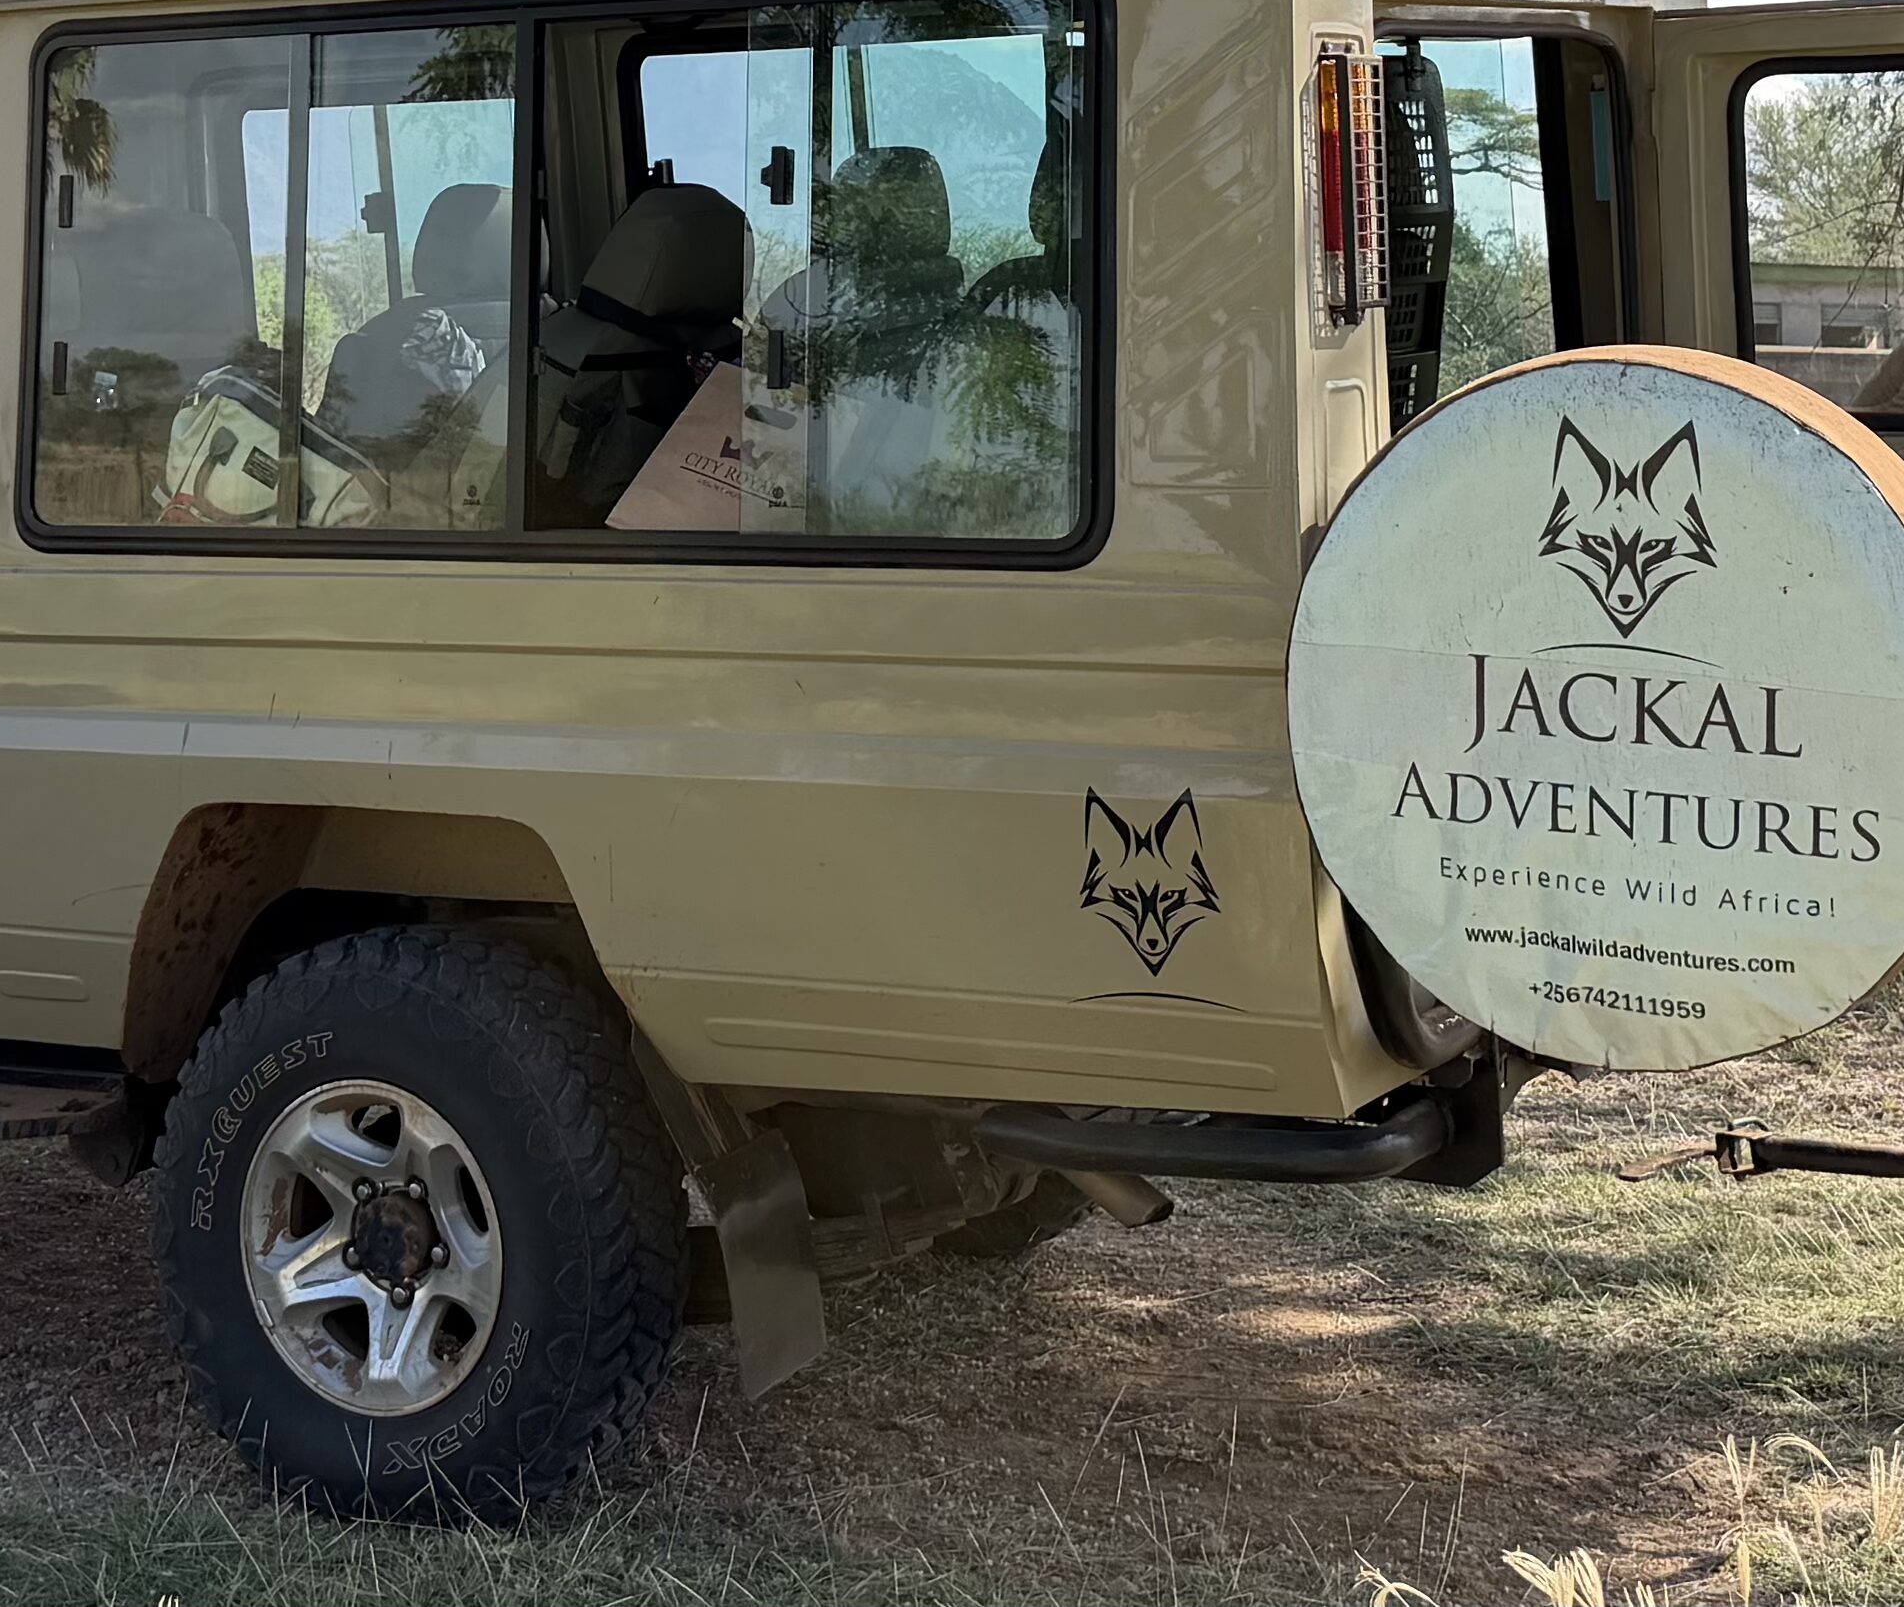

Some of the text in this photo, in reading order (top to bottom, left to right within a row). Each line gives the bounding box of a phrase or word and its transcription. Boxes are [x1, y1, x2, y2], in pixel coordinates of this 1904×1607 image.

[684, 451, 724, 475] CITY
[1463, 653, 1803, 758] JACKAL
[1390, 760, 1882, 863] ADVENTURES
[1439, 856, 1837, 918] Experience Wild Africa!
[1464, 926, 1796, 974] www.jackalwildadventures.com
[1528, 981, 1707, 1021] +256742111959
